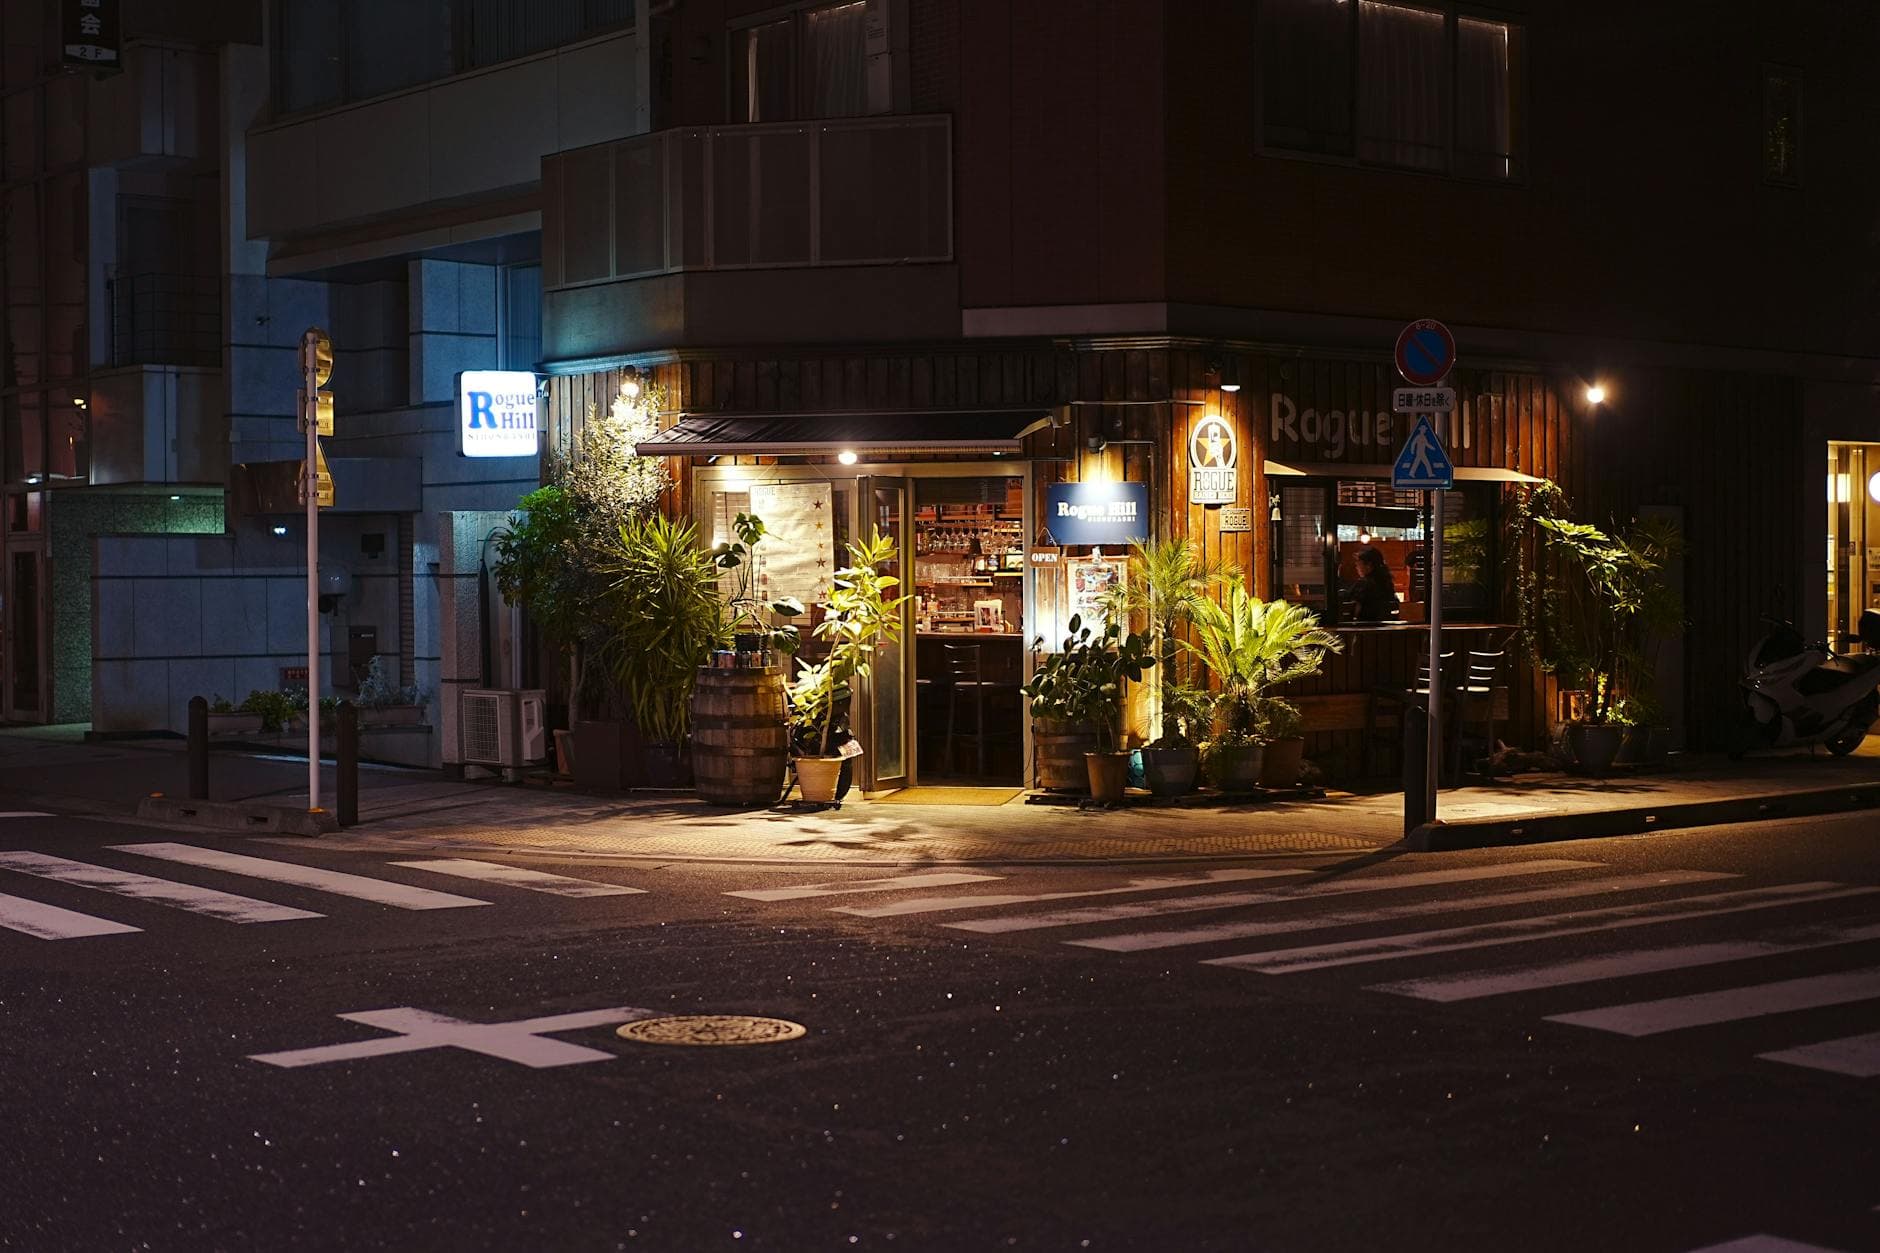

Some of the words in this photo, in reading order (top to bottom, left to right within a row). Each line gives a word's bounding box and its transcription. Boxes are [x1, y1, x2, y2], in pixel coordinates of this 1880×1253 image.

[467, 391, 535, 429] Rogue
[501, 412, 534, 429] Hill
[1271, 392, 1391, 459] Rogue
[1193, 471, 1234, 491] ROGUE
[1057, 502, 1105, 519] Rogue
[1107, 501, 1137, 516] Hill
[1031, 553, 1058, 562] OPEN
